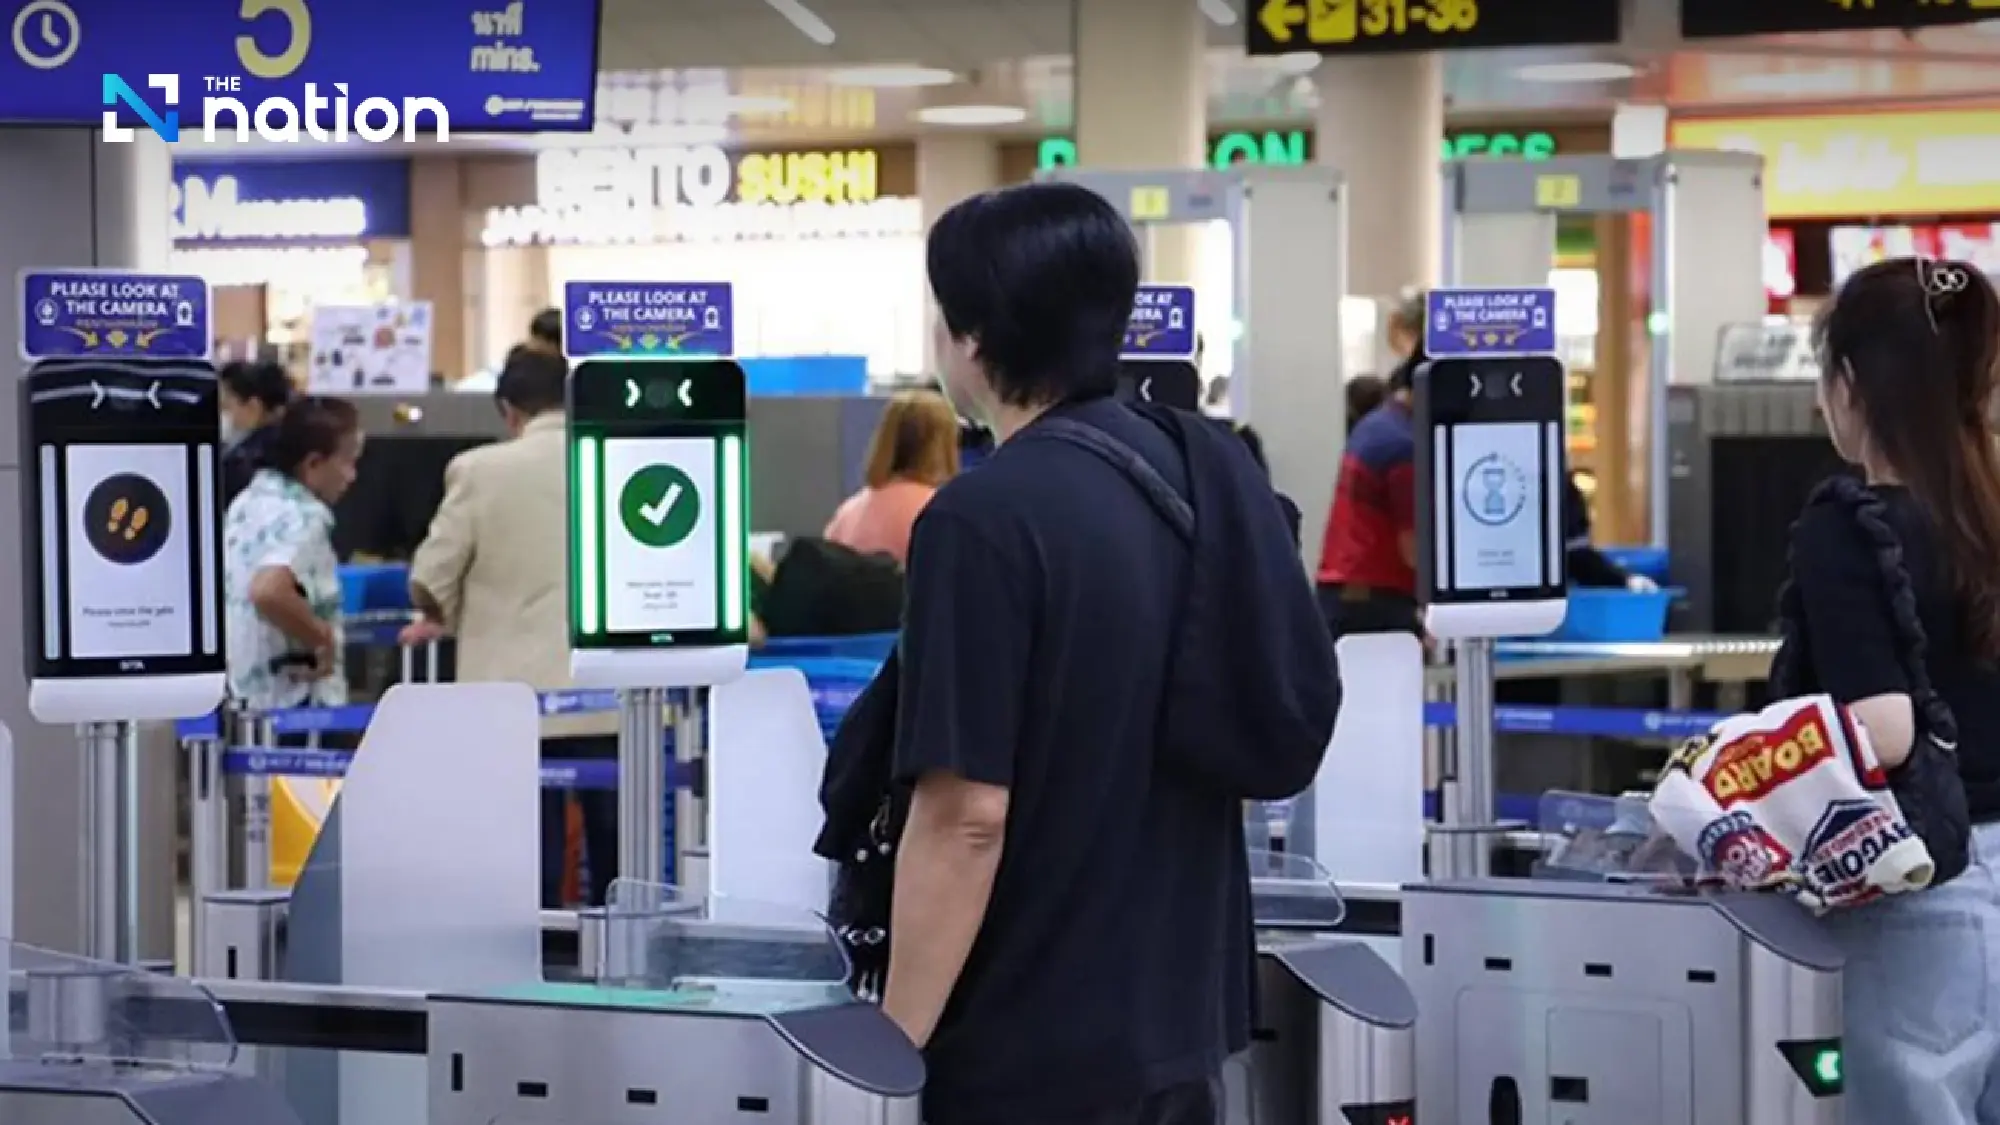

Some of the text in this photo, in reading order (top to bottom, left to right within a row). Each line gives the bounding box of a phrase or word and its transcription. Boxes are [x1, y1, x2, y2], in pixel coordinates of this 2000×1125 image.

[471, 40, 541, 72] mins.
[737, 151, 877, 203] SUSHI
[51, 282, 179, 299] PLEASE LOOK AT
[588, 291, 708, 305] PLEASE LOOK AT
[65, 300, 168, 316] THE CAMERA
[1445, 294, 1536, 308] PLEASE LOOK AT
[603, 308, 695, 320] THE CAMERA
[1455, 309, 1527, 322] THE CAMERA
[1714, 720, 1824, 799] BOARD
